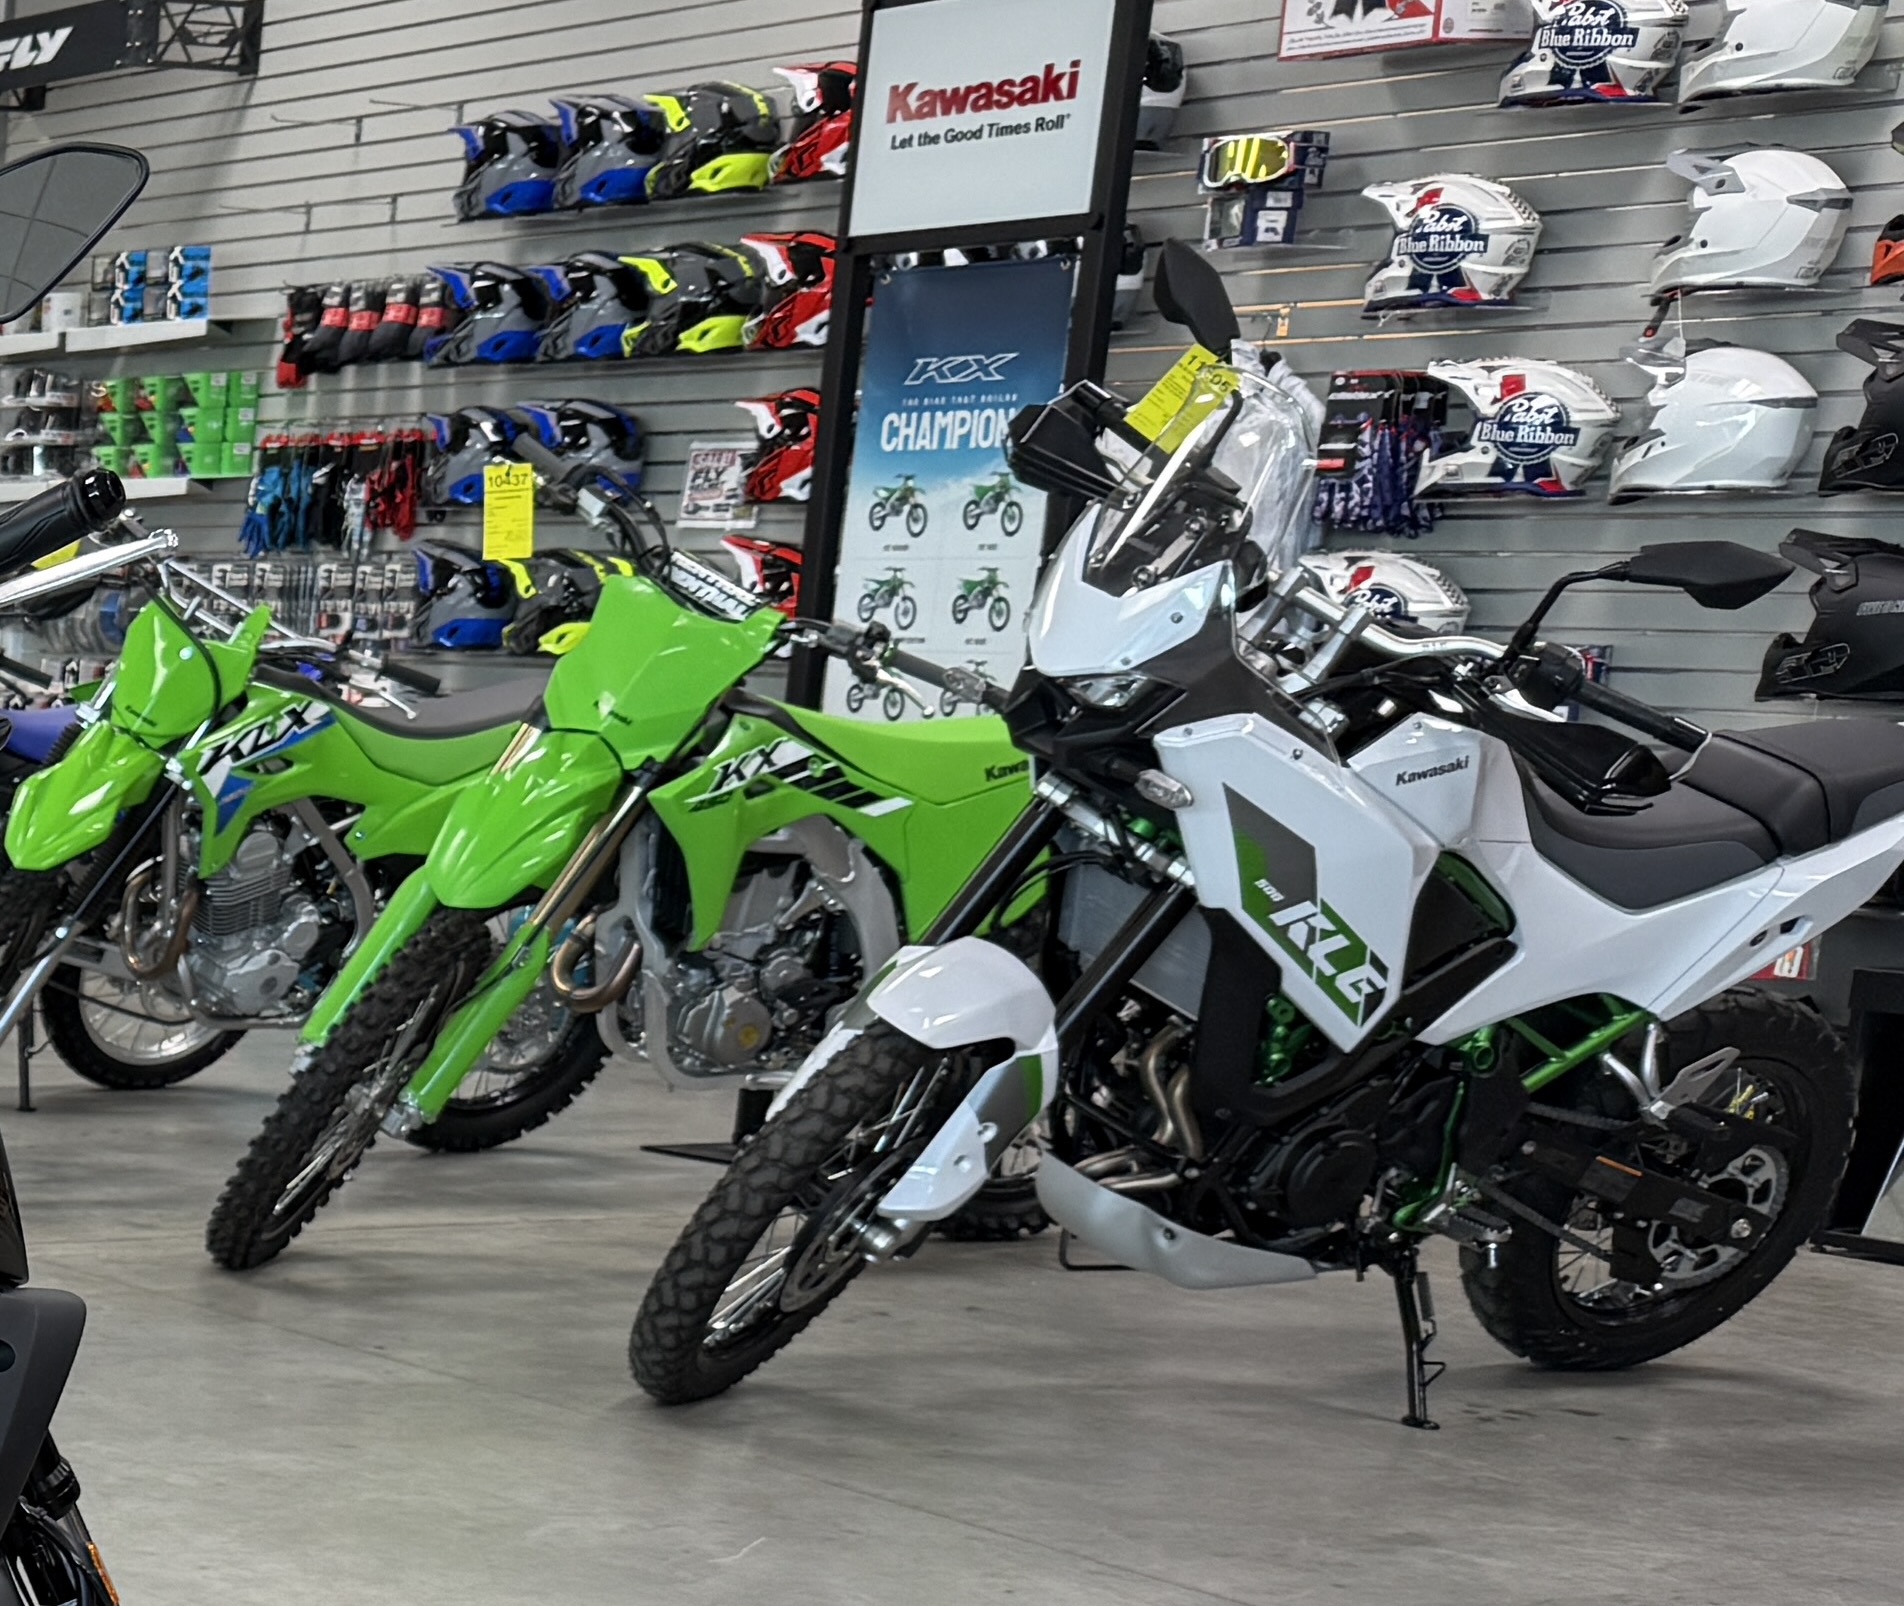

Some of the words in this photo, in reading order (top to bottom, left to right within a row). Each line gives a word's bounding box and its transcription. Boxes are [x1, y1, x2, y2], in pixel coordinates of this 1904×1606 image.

[1540, 27, 1571, 47] Blue
[1572, 27, 1634, 47] Ribbon
[886, 59, 1081, 124] Kawasaki
[891, 134, 913, 150] Let
[918, 131, 941, 146] the
[944, 124, 984, 143] Good
[987, 120, 1031, 138] Times
[1414, 209, 1468, 233] Pabst
[1398, 236, 1427, 255] Blue
[1429, 234, 1485, 252] Ribbon
[903, 352, 1020, 385] KX
[880, 407, 1018, 452] CHAMPION
[1481, 424, 1514, 441] Blue
[1517, 423, 1575, 445] Ribbon
[985, 760, 1029, 782] Kawa
[1395, 755, 1470, 786] Kawasaki
